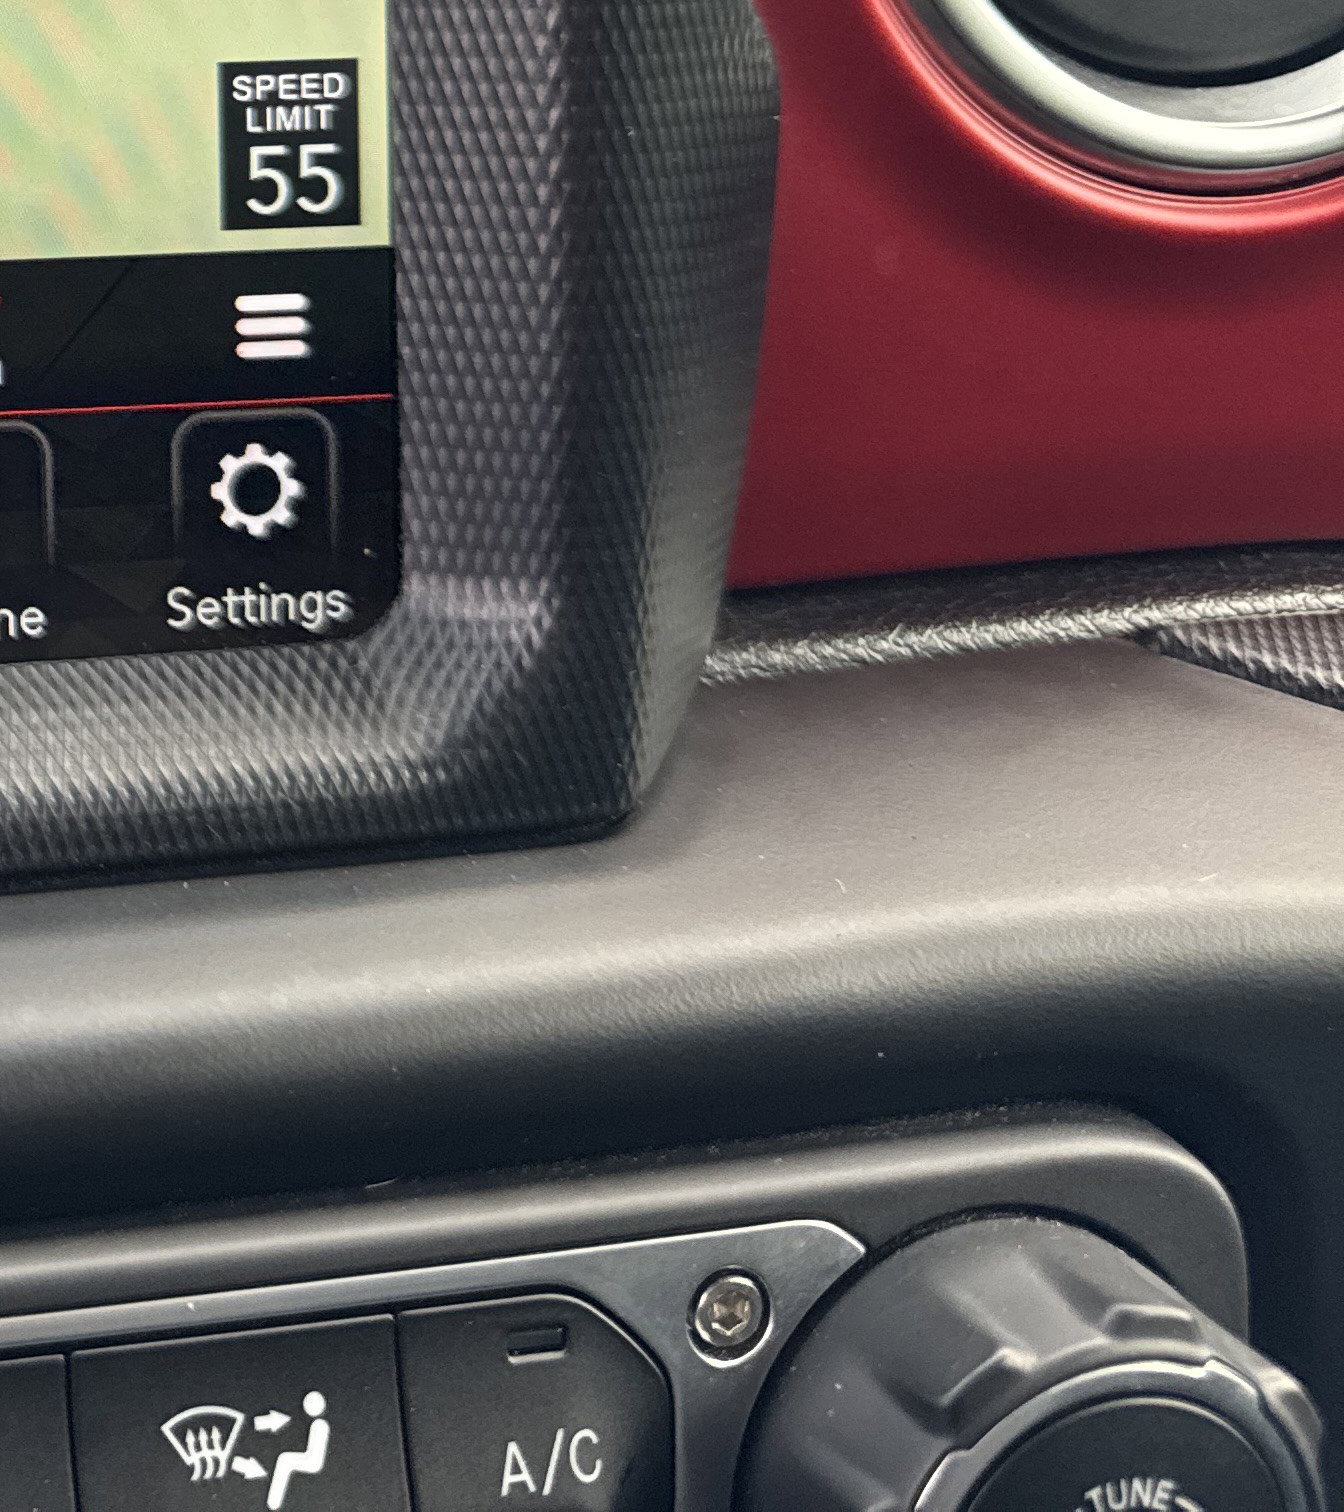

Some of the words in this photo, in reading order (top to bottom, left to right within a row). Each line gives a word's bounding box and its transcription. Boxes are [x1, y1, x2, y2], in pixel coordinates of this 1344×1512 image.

[232, 72, 349, 102] SPEED
[244, 104, 337, 134] LIMIT
[244, 142, 342, 216] 55
[164, 581, 352, 632] Settings
[498, 1424, 605, 1495] A/C
[1083, 1476, 1178, 1512] TUNE
